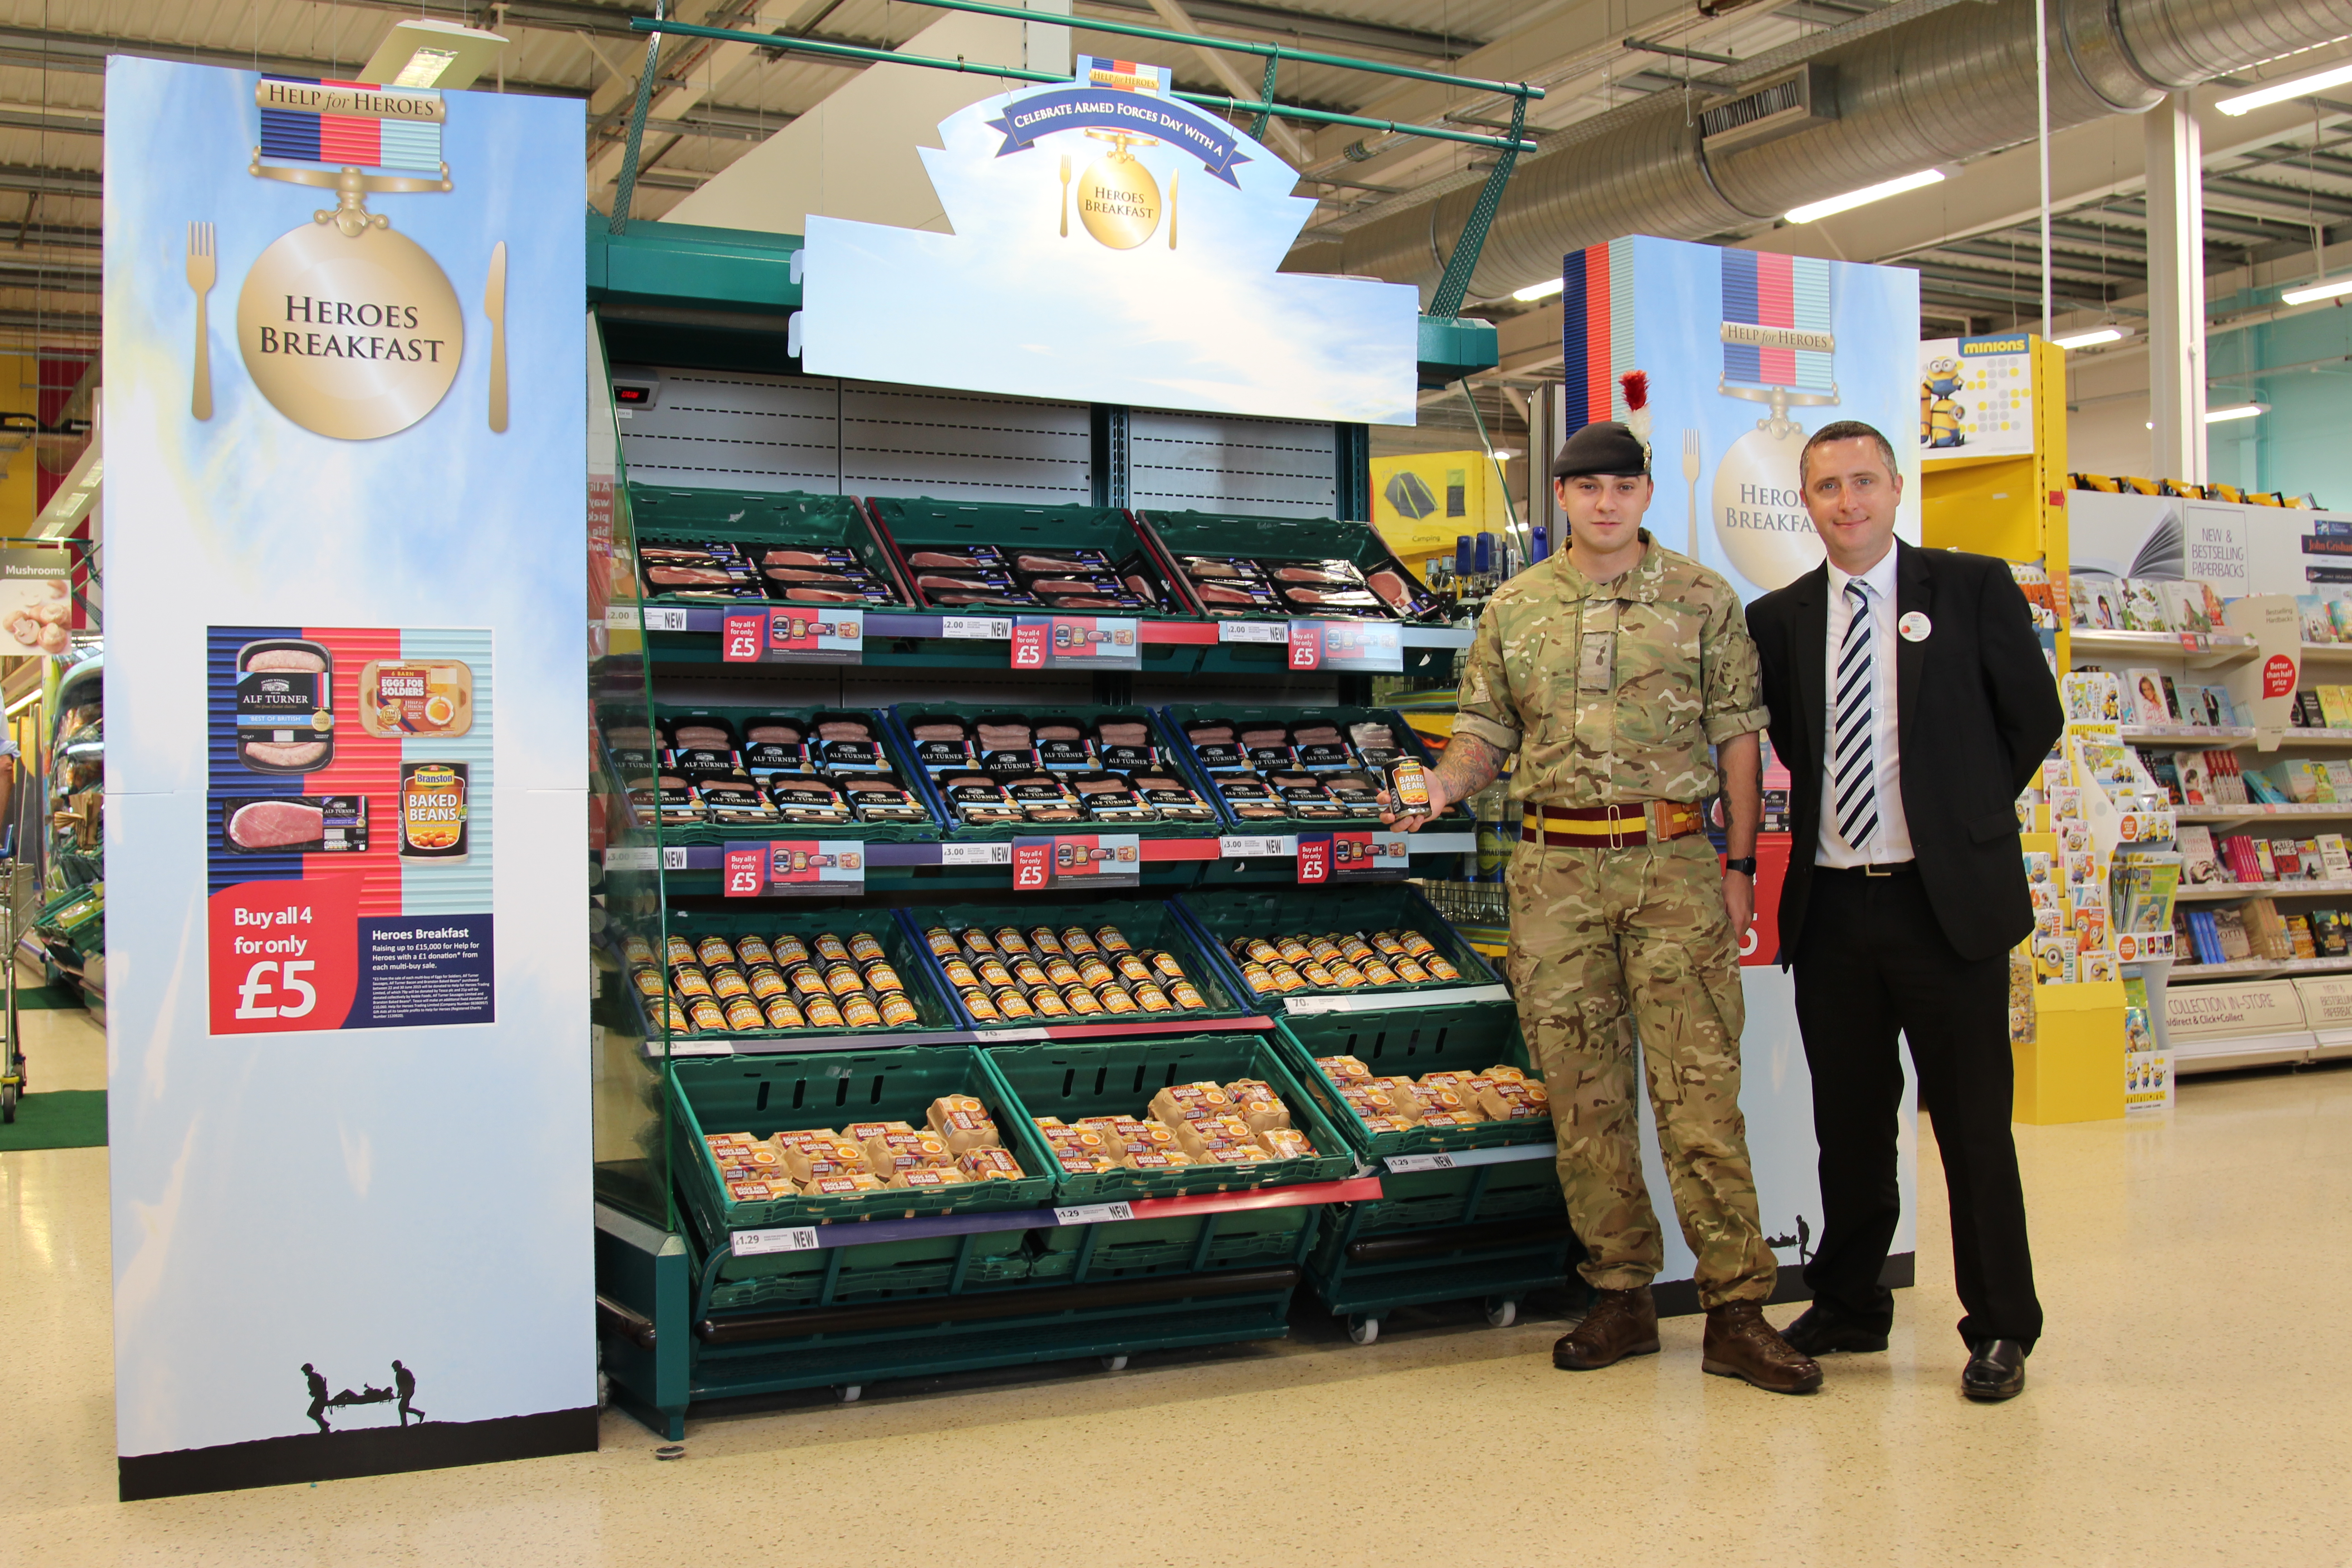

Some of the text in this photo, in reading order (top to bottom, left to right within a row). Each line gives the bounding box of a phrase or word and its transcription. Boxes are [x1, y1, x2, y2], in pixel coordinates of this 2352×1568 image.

[1093, 71, 1155, 88] HELP for HEROES
[269, 84, 434, 117] HELP for HEROES
[1014, 102, 1223, 157] CELEBRATE ARMED FORCES DAY WITH A
[1095, 186, 1145, 204] HEROES
[1085, 200, 1154, 220] BREAKFAST
[284, 294, 418, 329] HEROES
[258, 326, 445, 362] BREAKFAST
[1728, 325, 1827, 348] HELP for HEROES
[2202, 528, 2232, 543] NEW &
[2192, 544, 2244, 561] BESTSELLING
[2309, 539, 2326, 551] John
[6, 565, 65, 575] Mushrooms
[2192, 562, 2244, 578] PAPERBACKS
[607, 612, 683, 629] £2.00 NEW
[991, 621, 1008, 638] NEW
[1270, 627, 1285, 641] NEW
[730, 637, 755, 657] £5
[1017, 646, 1039, 664] £5
[2270, 662, 2288, 670] Better
[2281, 670, 2293, 678] half
[382, 679, 424, 687] EGGS FOR
[2272, 679, 2287, 687] price
[243, 695, 308, 703] ALF TURNER
[382, 688, 425, 696] SOLDIERS
[417, 774, 452, 782] Branston
[1399, 774, 1424, 784] BAKED
[1401, 782, 1426, 791] BEANS
[409, 795, 457, 807] BAKED
[410, 808, 456, 821] BEANS
[1266, 839, 1281, 854] NEW
[2274, 848, 2297, 856] JAMES
[665, 851, 683, 867] NEW
[992, 847, 1008, 863] NEW
[1303, 861, 1323, 878] £5
[731, 872, 756, 891] £5
[234, 906, 312, 929] Buy all 4
[372, 927, 469, 940] Heroes Breakfast
[234, 935, 307, 956] for only
[454, 942, 469, 950] Help
[754, 975, 779, 987] BAKED
[756, 980, 781, 991] BEANS
[235, 960, 316, 1019] £5
[2168, 993, 2275, 1014] COLLECTION IN-STORE
[2193, 1016, 2199, 1024] &
[2200, 1013, 2244, 1024] Click+Collect
[1433, 1155, 1453, 1167] NEW
[1058, 1205, 1130, 1219] £1.29 NEW
[736, 1235, 759, 1245] £1.29
[793, 1230, 814, 1248] NEW
